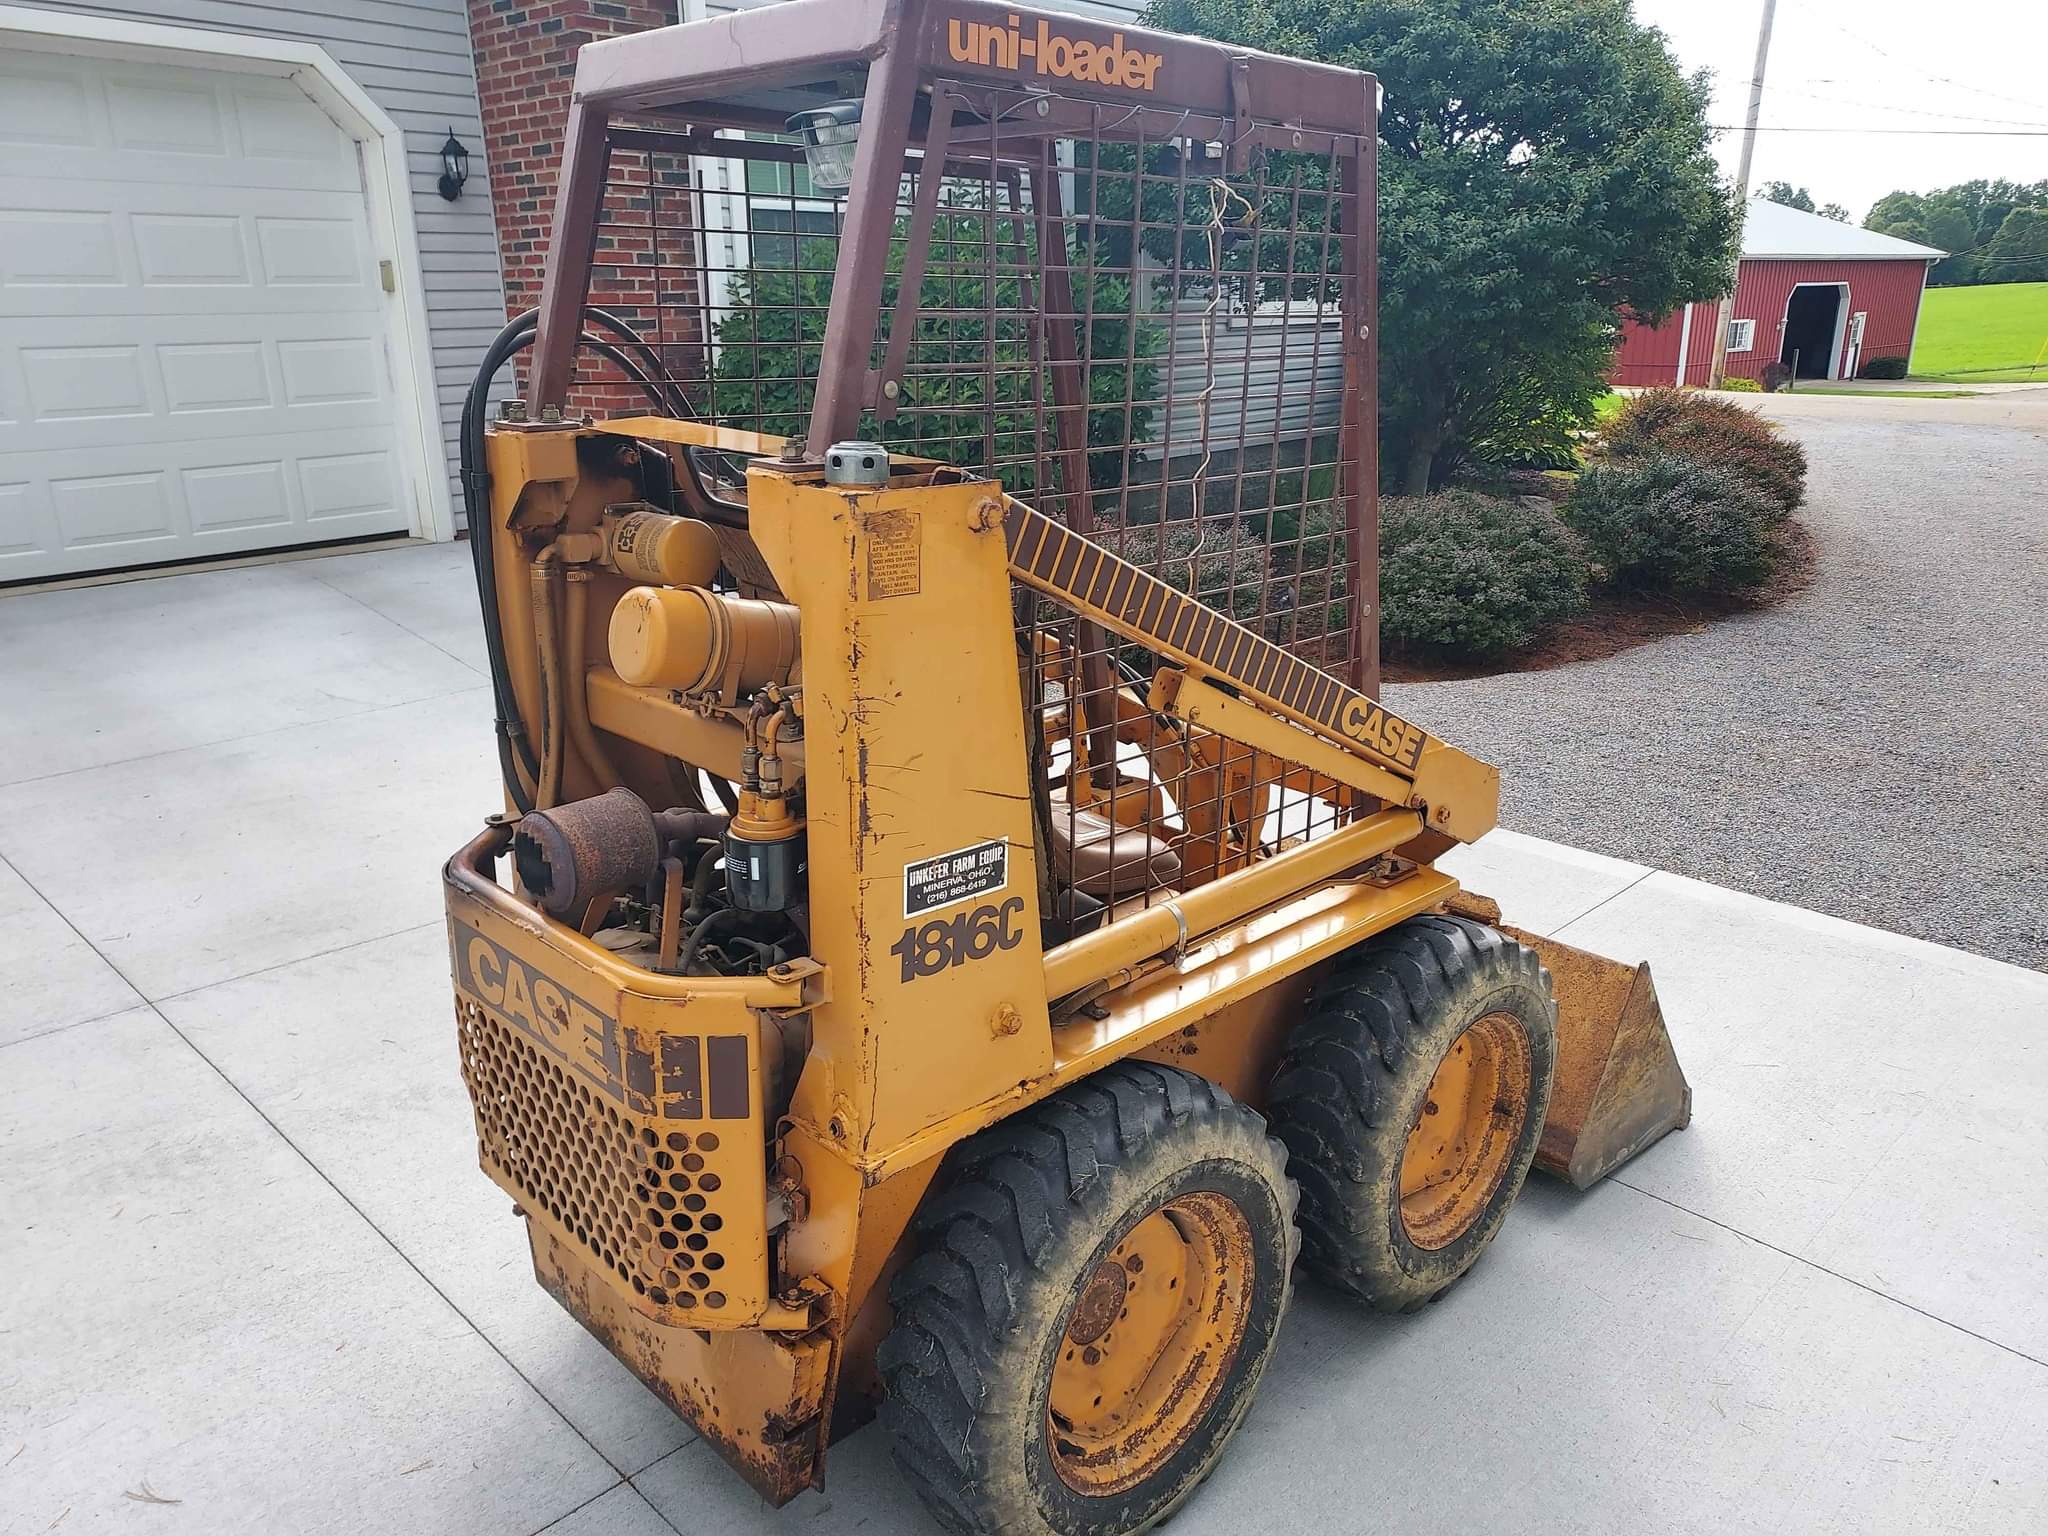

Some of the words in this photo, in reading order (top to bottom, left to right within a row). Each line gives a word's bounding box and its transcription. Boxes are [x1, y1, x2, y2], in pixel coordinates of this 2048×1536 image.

[948, 15, 1162, 91] uni-loader
[1342, 696, 1423, 767] CASE
[909, 862, 949, 887] UNKEFER
[953, 854, 976, 873] FARM
[927, 890, 948, 904] (216)
[890, 896, 1025, 984] 1816C
[468, 936, 611, 1084] CASE
